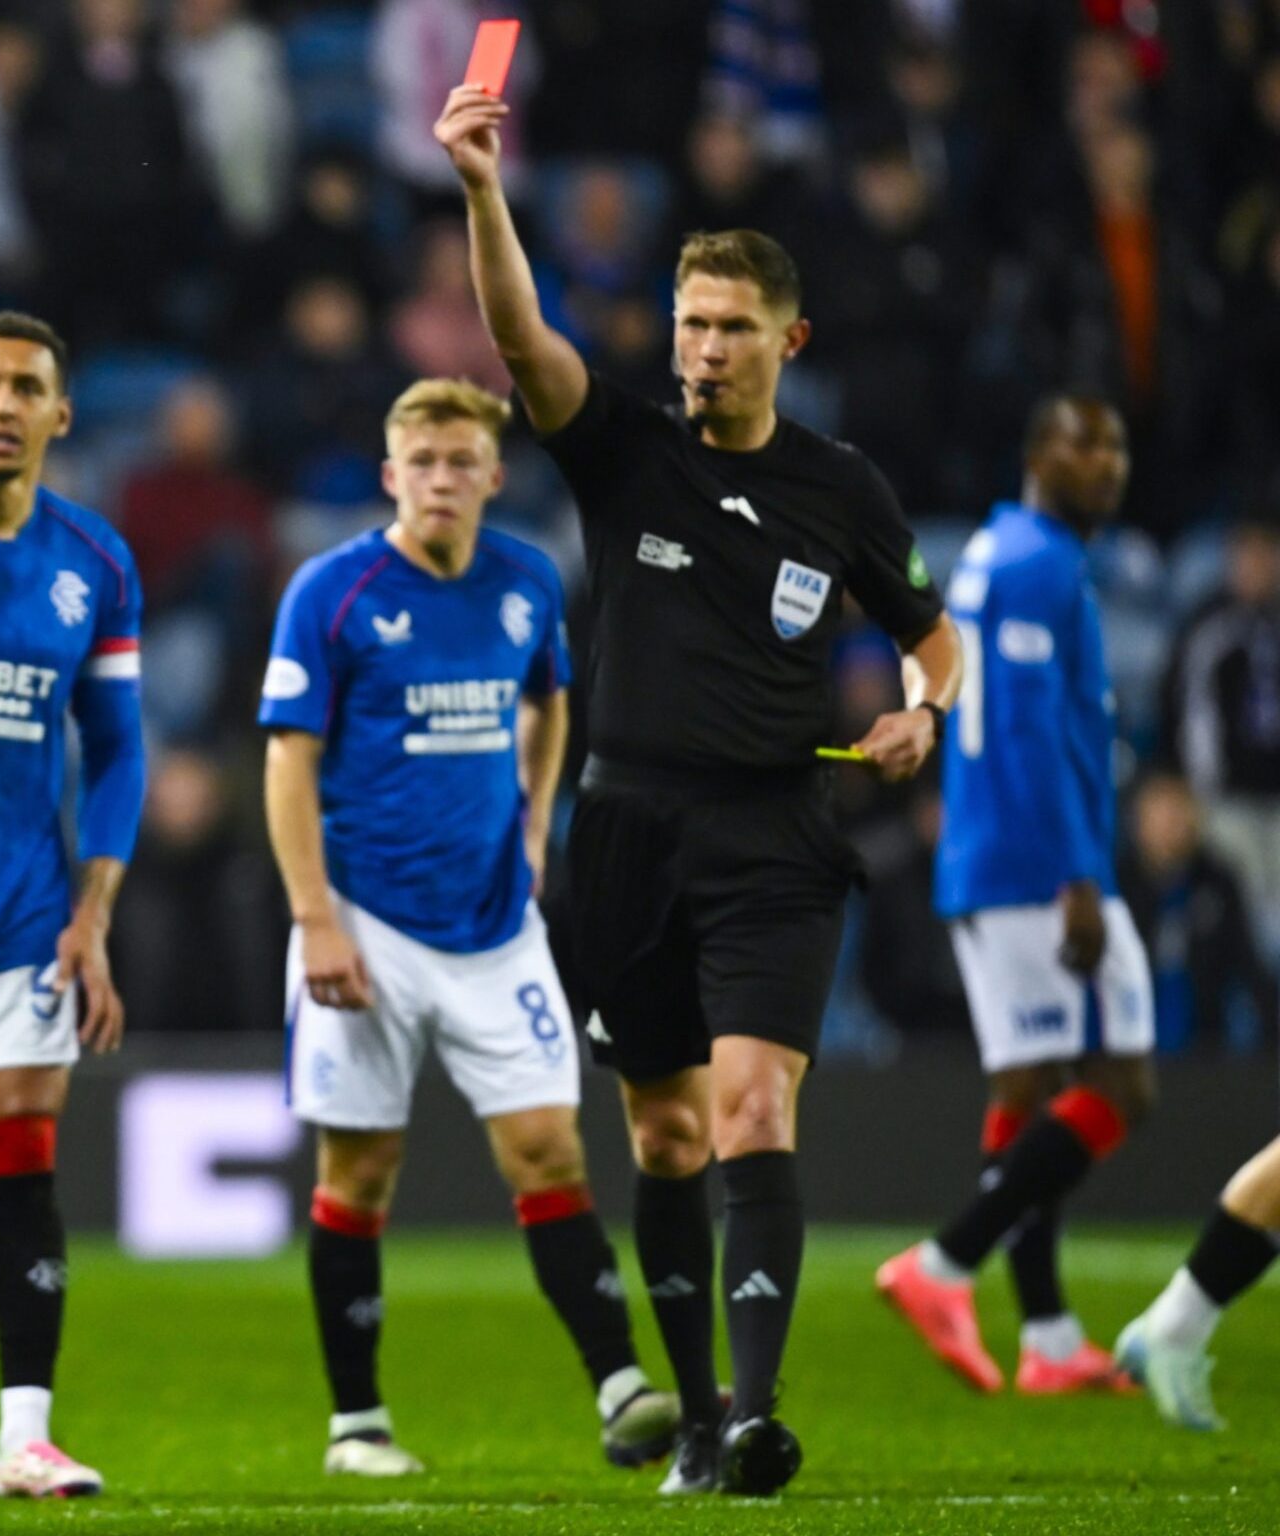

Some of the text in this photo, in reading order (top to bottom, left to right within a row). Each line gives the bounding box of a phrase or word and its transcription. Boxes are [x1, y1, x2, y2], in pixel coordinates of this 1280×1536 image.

[784, 567, 823, 596] FIFA
[405, 678, 518, 716] UNIBET
[516, 981, 560, 1041] 8
